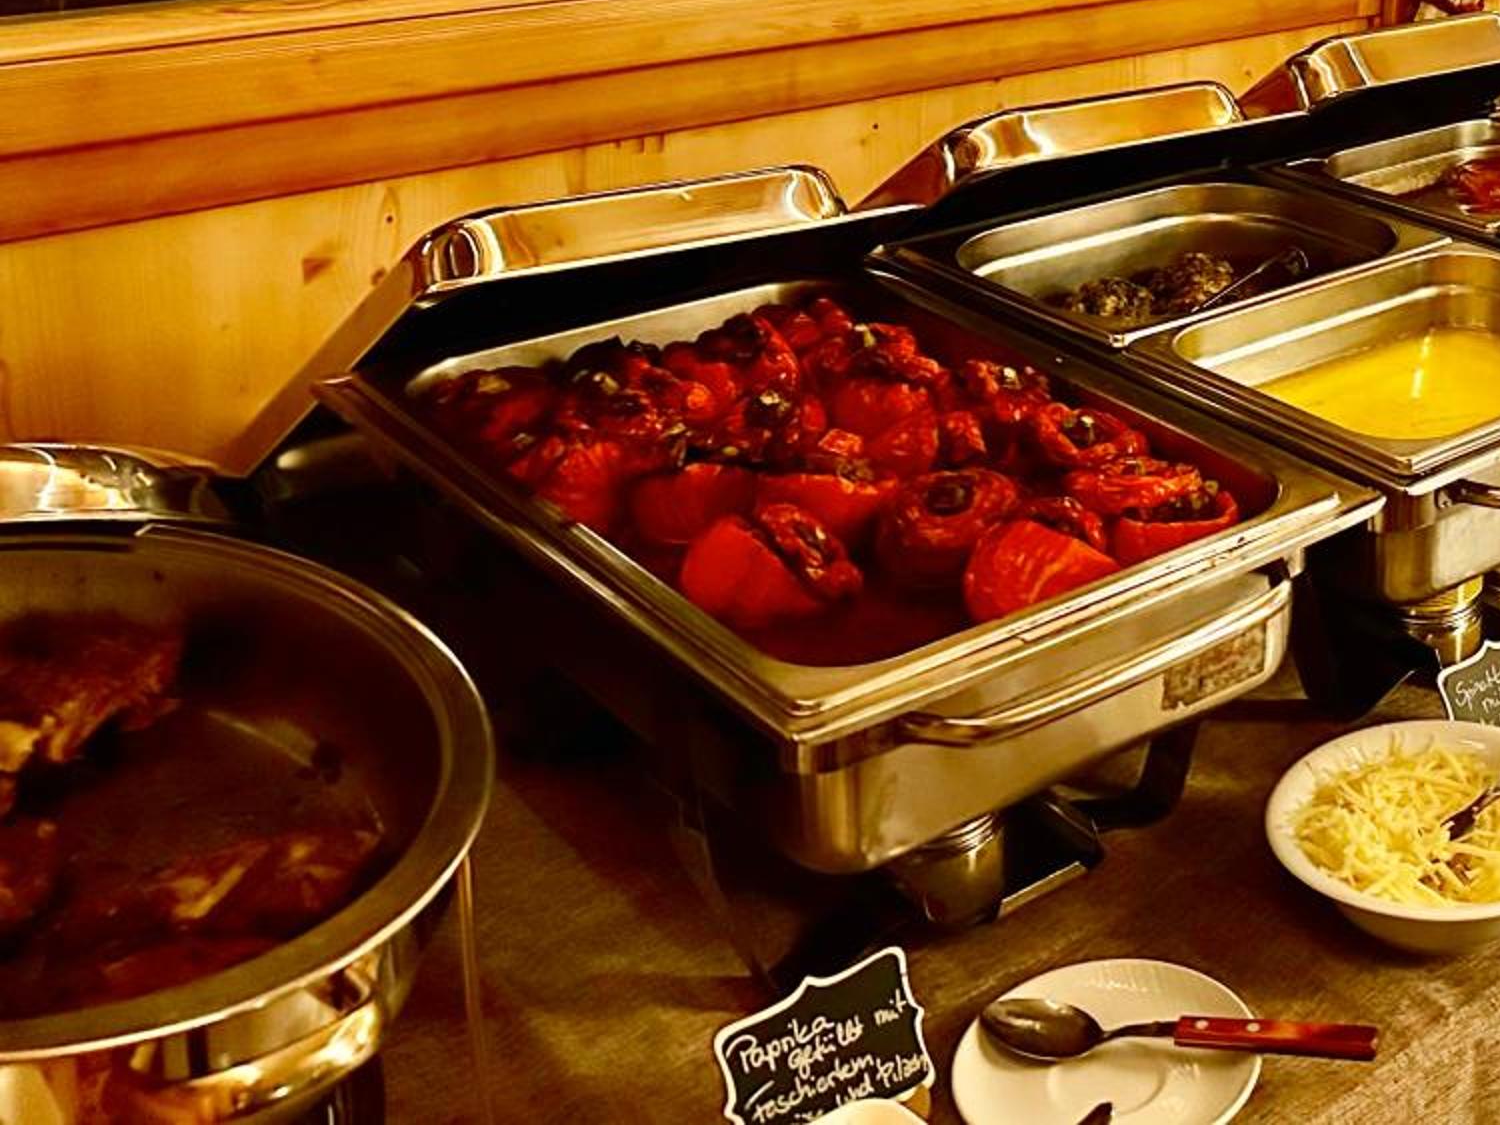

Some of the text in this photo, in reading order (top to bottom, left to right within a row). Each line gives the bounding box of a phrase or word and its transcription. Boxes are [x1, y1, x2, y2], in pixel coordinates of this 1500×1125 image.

[725, 1016, 835, 1074] Paprika
[787, 988, 908, 1079] gefüllt mit
